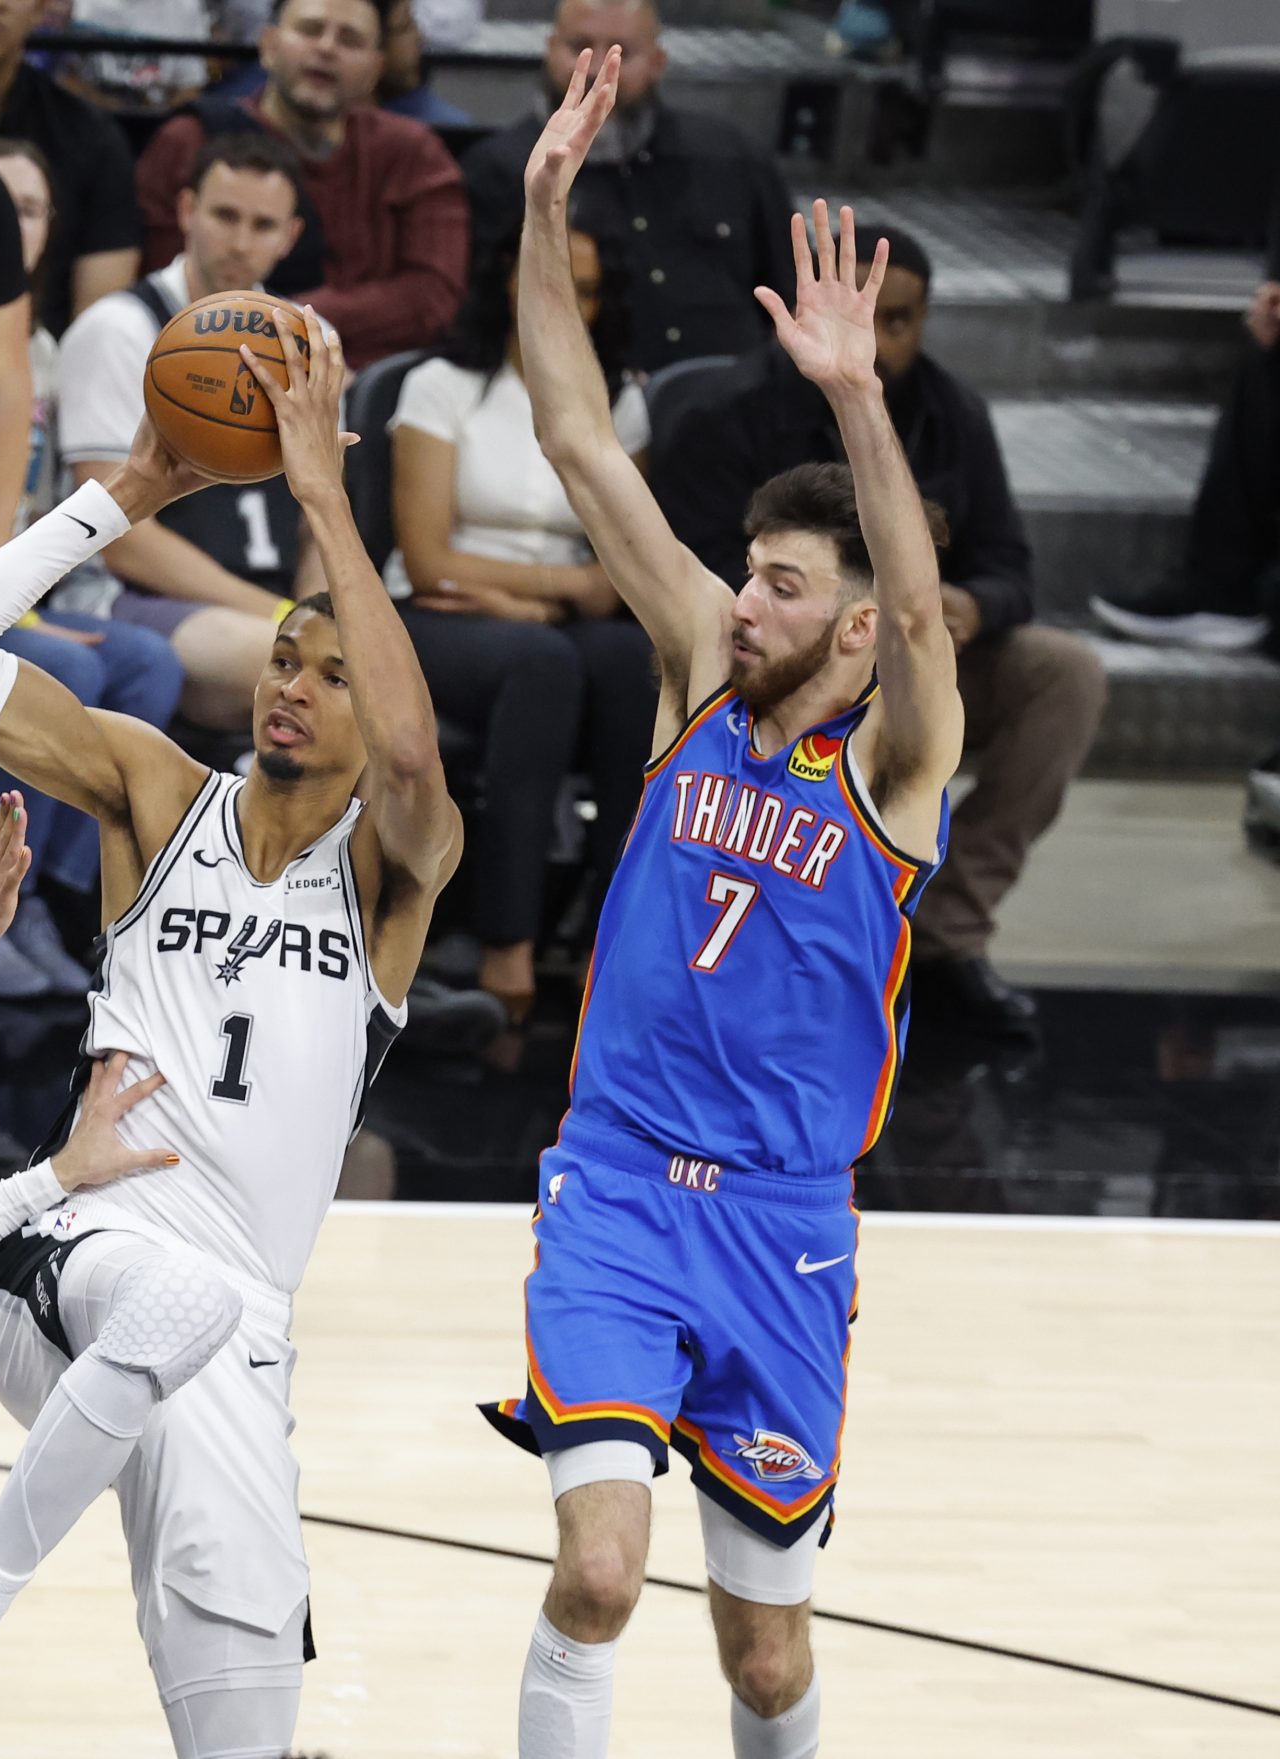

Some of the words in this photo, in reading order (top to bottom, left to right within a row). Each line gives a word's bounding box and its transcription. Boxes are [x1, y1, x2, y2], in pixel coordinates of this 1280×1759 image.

[237, 490, 280, 568] 1
[671, 771, 848, 891] THUNDER
[287, 876, 333, 890] LEDGER
[689, 869, 761, 974] 7
[157, 907, 350, 986] SPURS
[208, 1011, 254, 1106] 1
[668, 1155, 721, 1193] OKC
[741, 1445, 801, 1467] OKC
